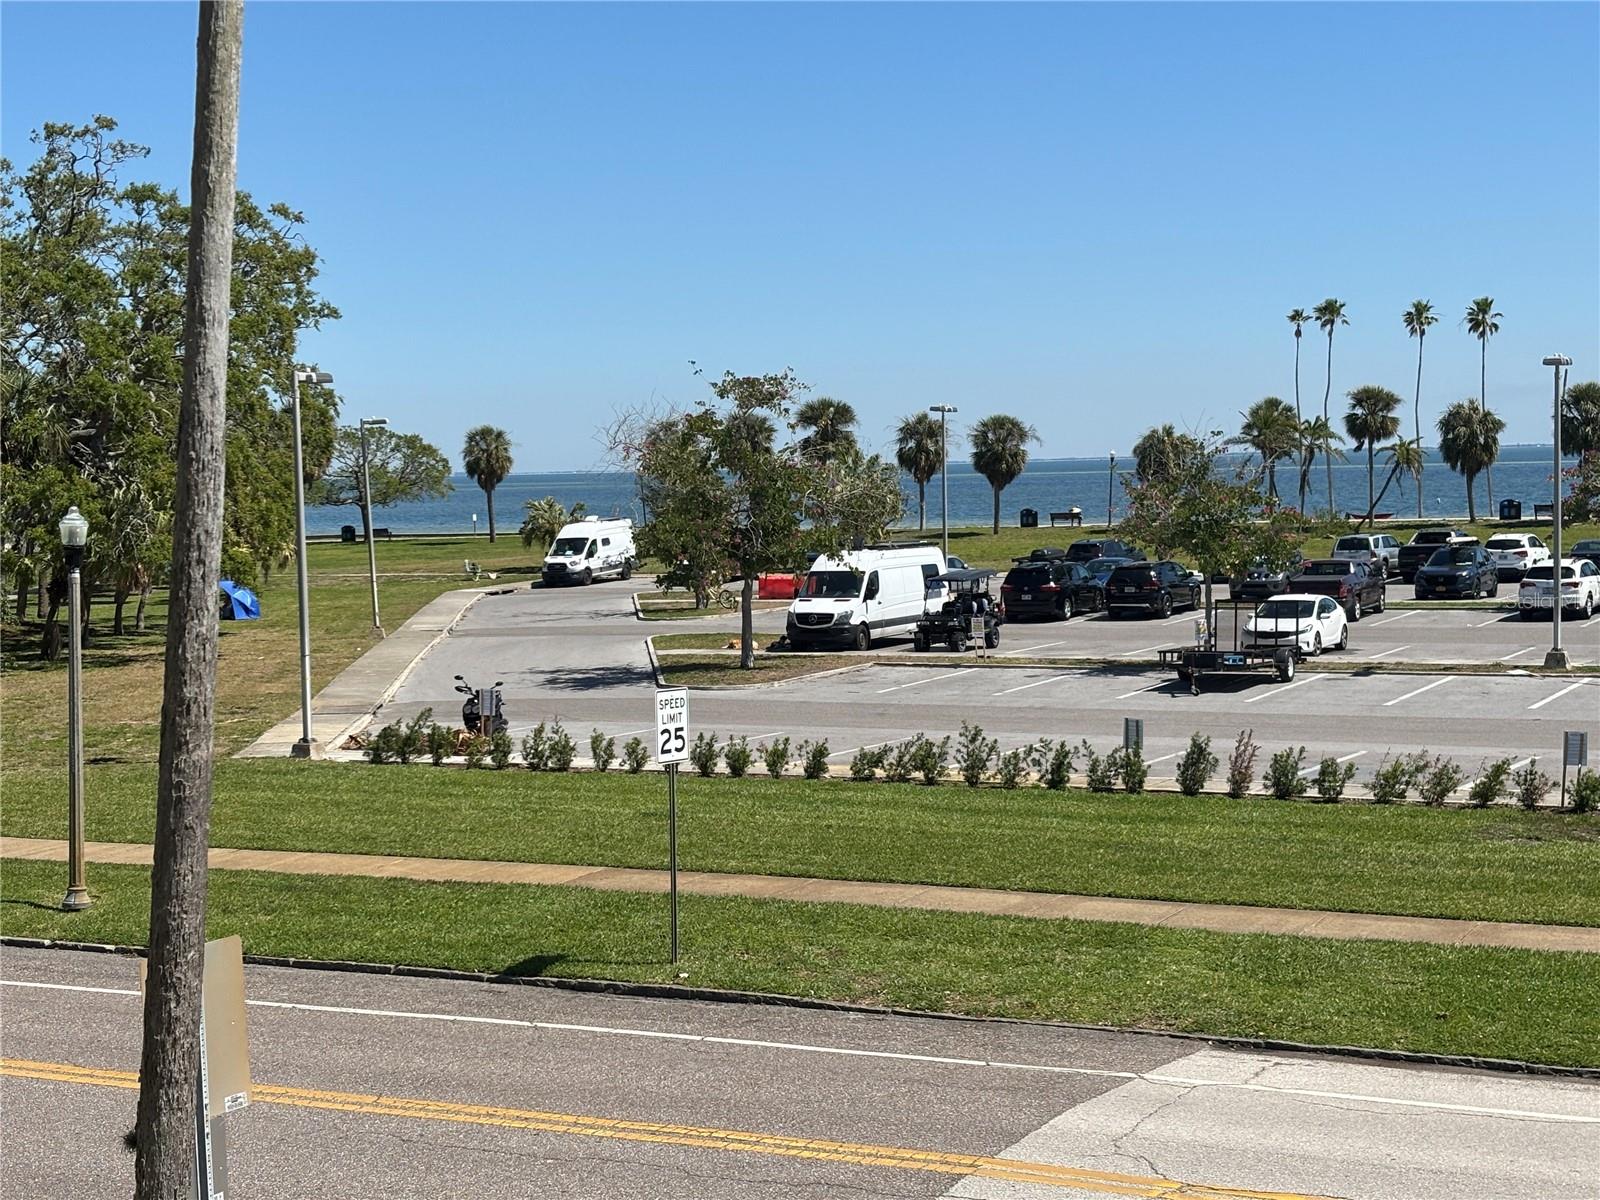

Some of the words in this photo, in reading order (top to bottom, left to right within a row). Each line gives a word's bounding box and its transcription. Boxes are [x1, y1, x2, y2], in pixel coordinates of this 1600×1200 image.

[659, 697, 685, 710] SPEED
[661, 712, 682, 725] LIMIT
[660, 726, 685, 754] 25
